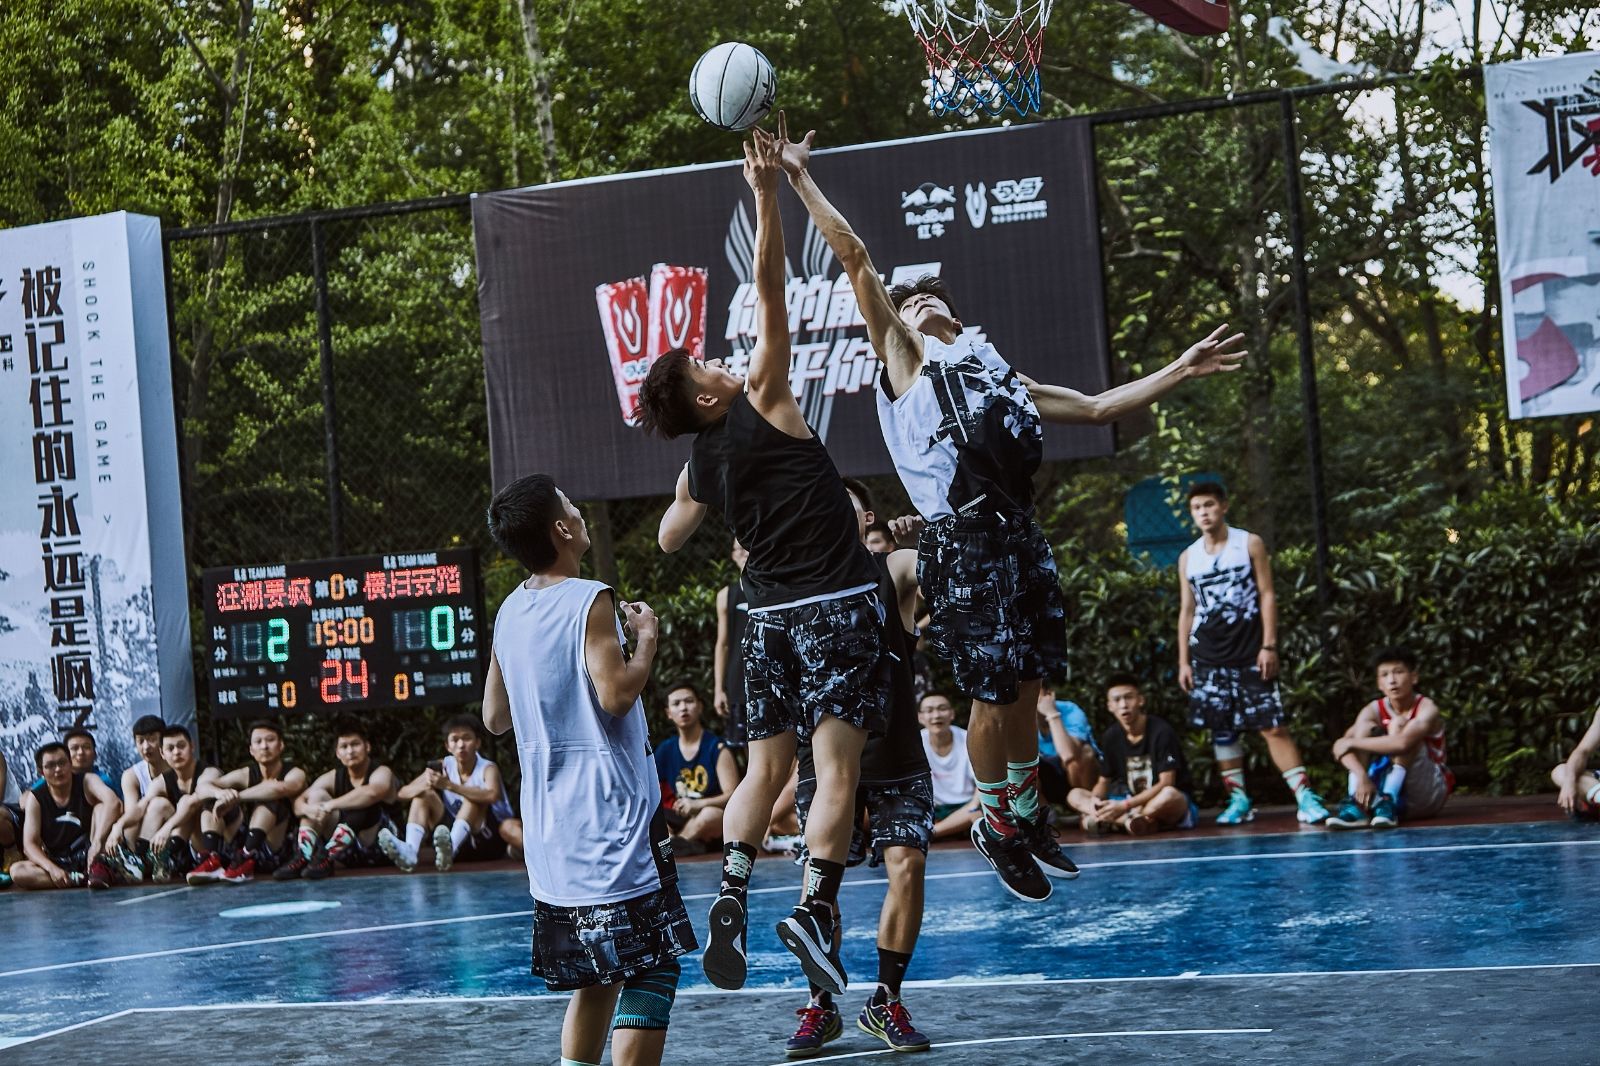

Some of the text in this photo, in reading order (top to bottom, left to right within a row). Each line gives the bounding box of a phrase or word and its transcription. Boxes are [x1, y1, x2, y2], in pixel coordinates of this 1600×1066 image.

[82, 261, 112, 482] SHOCK THE GAME
[315, 617, 375, 647] 15:00
[430, 605, 455, 651] 0
[281, 680, 297, 708] 0
[320, 659, 368, 703] 24
[394, 673, 409, 700] 0
